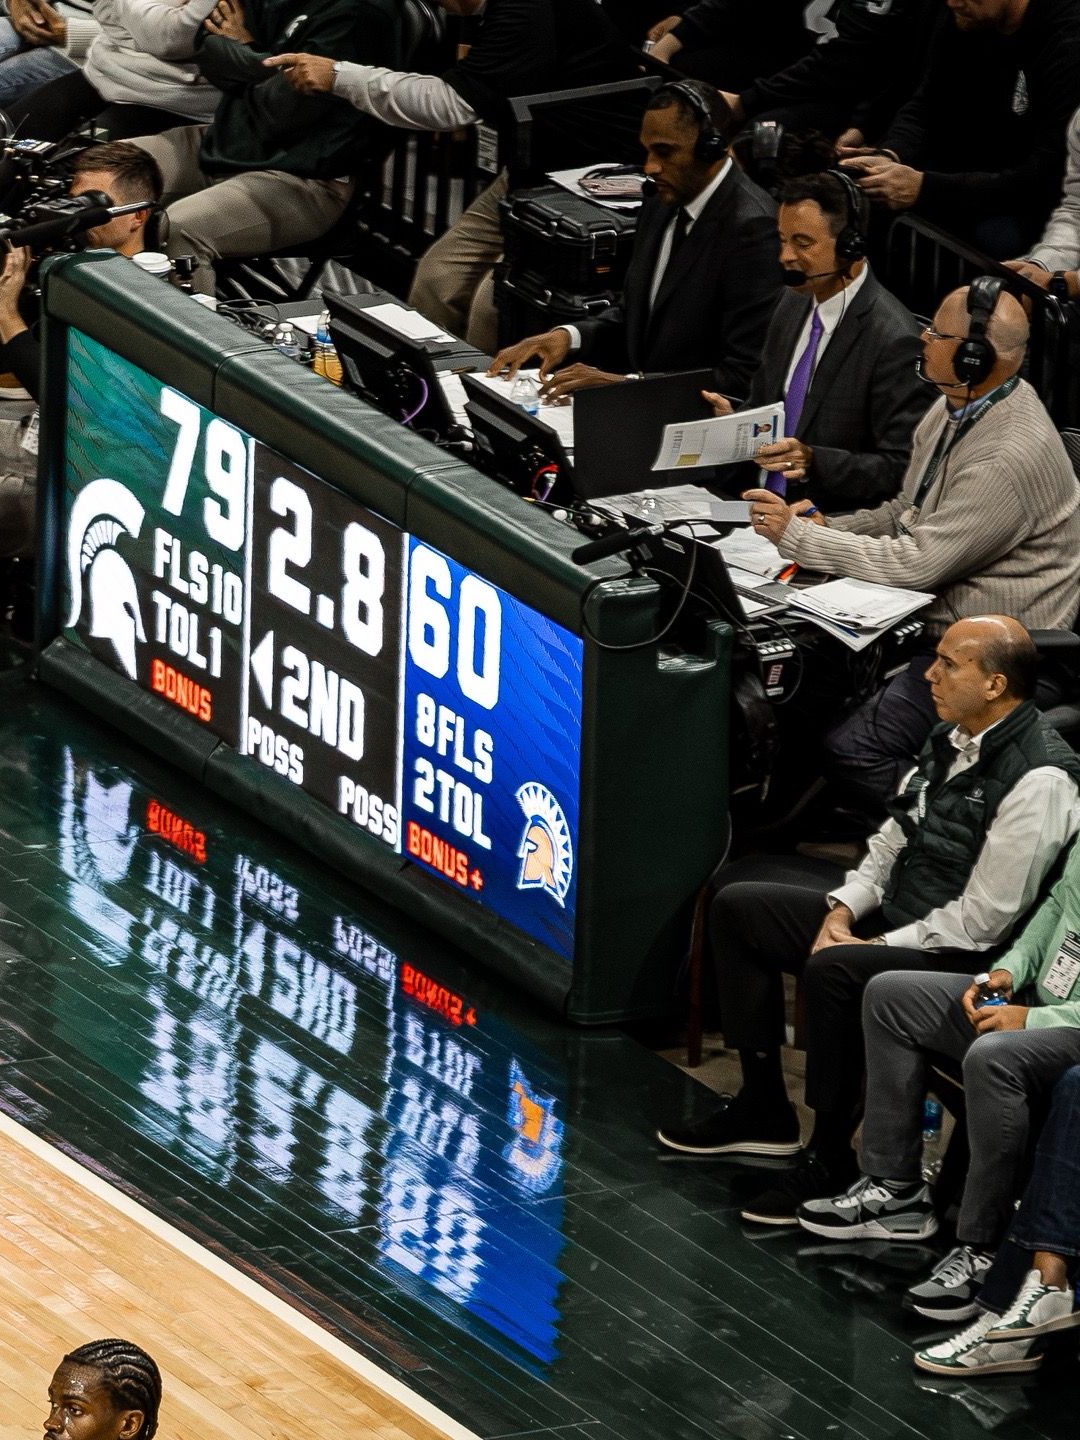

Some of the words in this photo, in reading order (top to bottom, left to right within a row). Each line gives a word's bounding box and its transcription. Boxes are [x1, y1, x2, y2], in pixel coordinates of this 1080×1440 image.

[161, 387, 246, 551] 79
[269, 477, 385, 656] 2.8
[409, 545, 502, 710] 60
[153, 659, 212, 722] BONUS
[281, 645, 365, 761] 2ND
[248, 716, 304, 785] POSS
[338, 775, 397, 844] POSS
